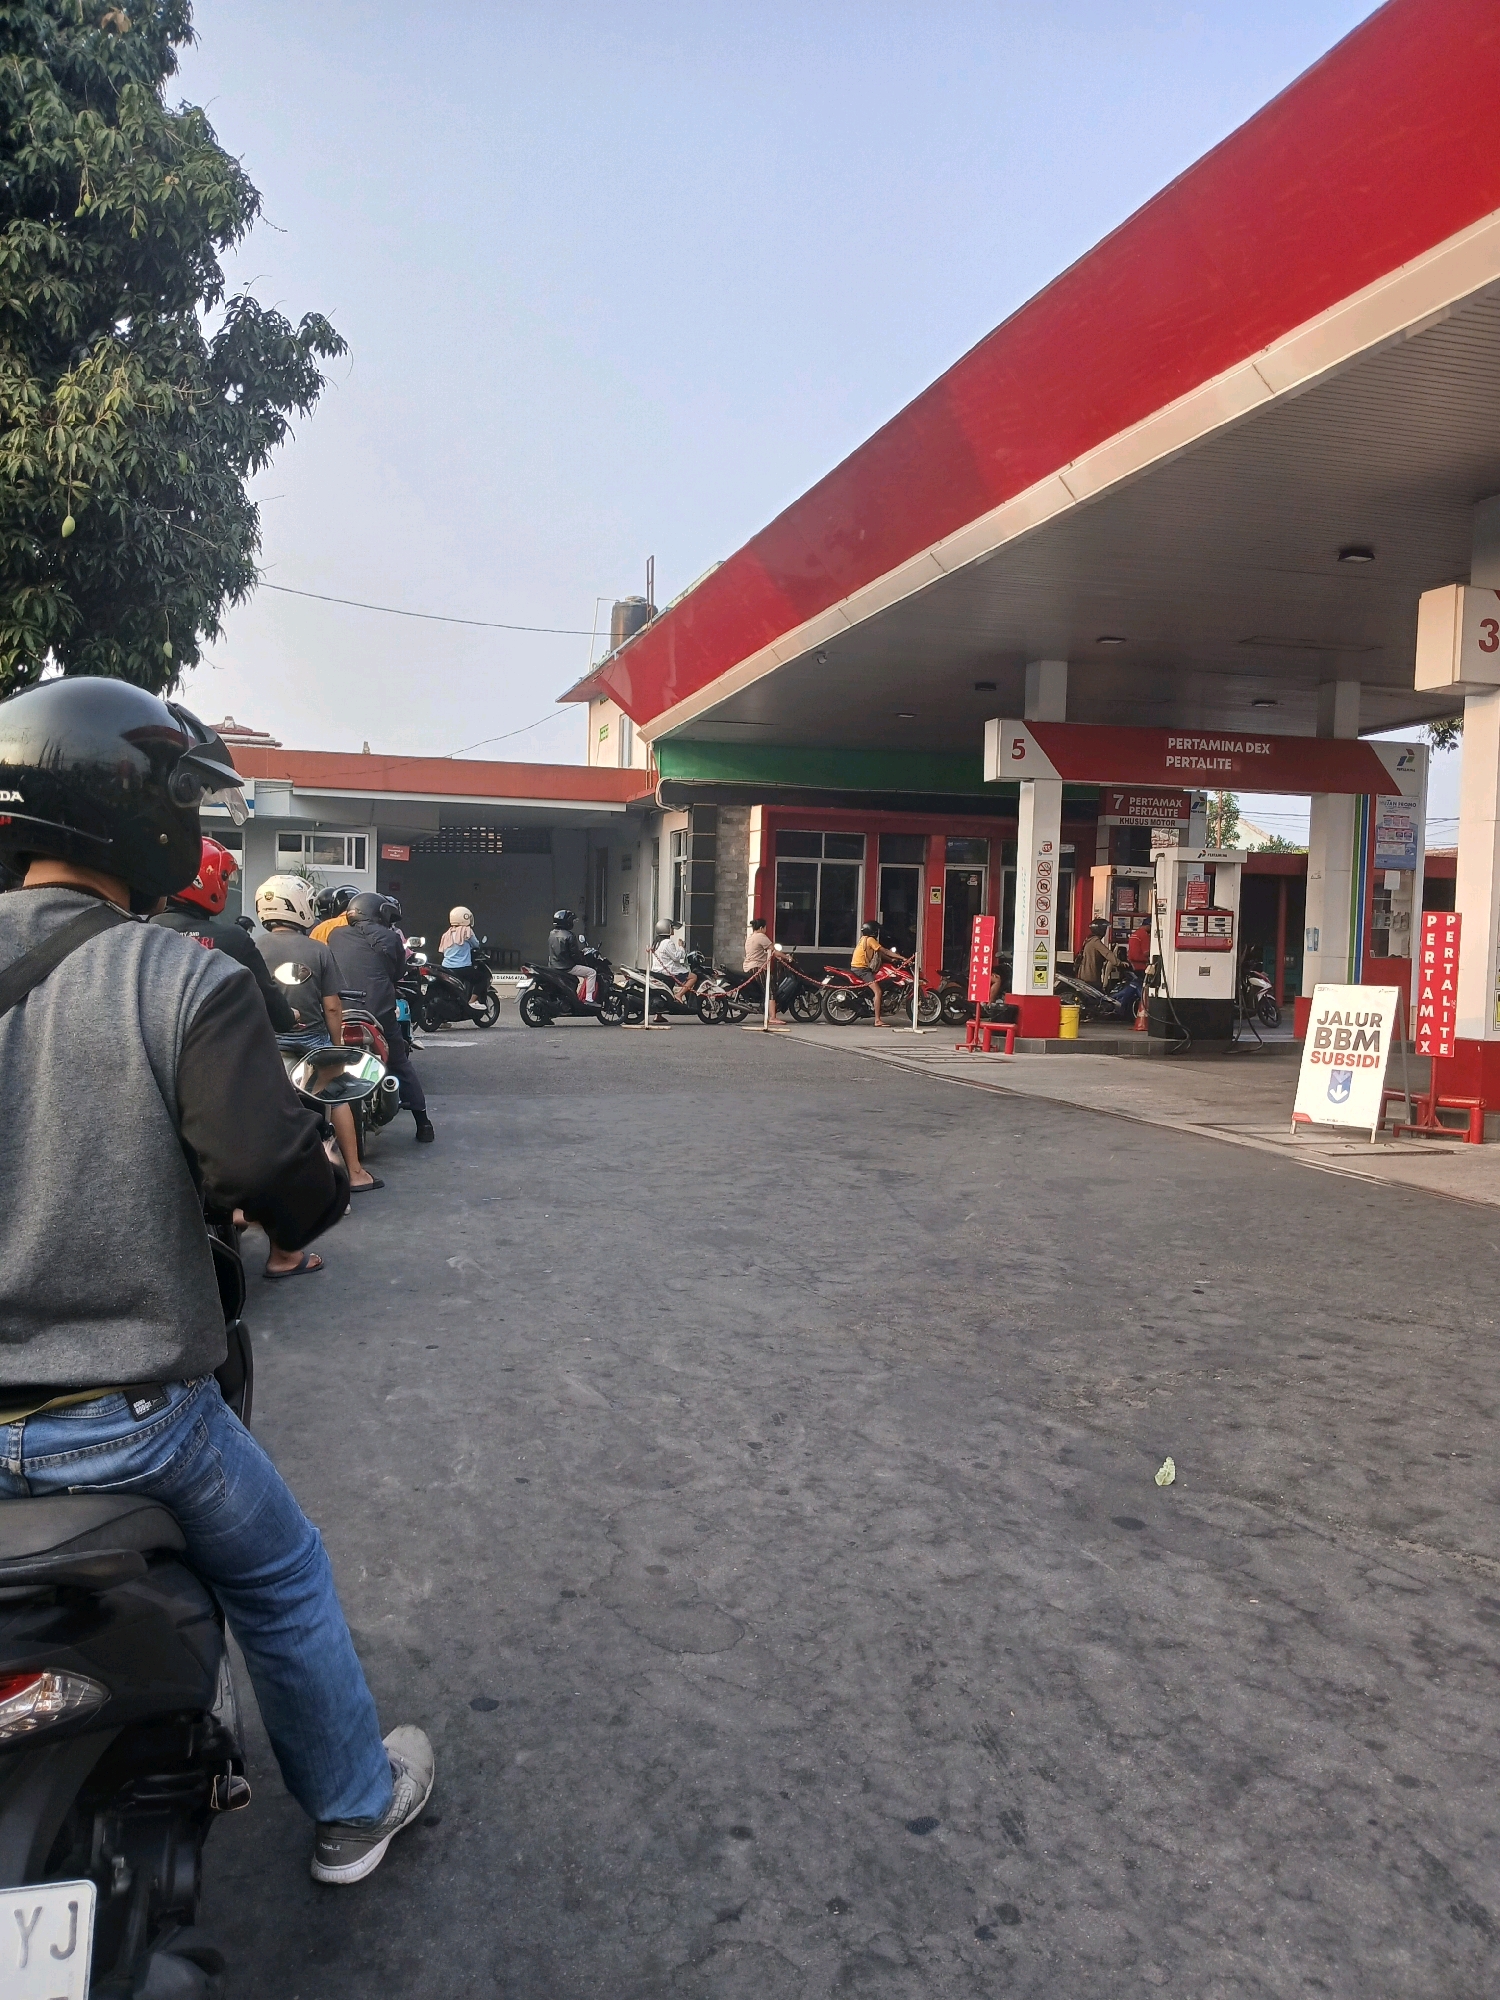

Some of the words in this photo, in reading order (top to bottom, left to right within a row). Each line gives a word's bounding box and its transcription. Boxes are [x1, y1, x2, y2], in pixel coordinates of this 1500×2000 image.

[1478, 617, 1500, 653] 3
[1011, 738, 1026, 760] 5
[1168, 737, 1244, 753] PERTAMINA
[1245, 742, 1271, 755] DEX
[1165, 755, 1232, 770] PERTALITE
[0, 790, 25, 803] DA
[1112, 793, 1125, 810] 7
[1129, 796, 1183, 808] PERTAMAX
[1128, 806, 1179, 818] PERTALITE
[1119, 817, 1149, 826] KHUSUS
[1149, 819, 1176, 827] MOTOR
[971, 917, 982, 1001] PERTALITE
[981, 945, 991, 976] DEX
[1419, 915, 1438, 1053] PERTAMAX
[1439, 915, 1456, 1055] PERTALITE
[1316, 1010, 1383, 1028] JALUR
[1313, 1026, 1381, 1053] BBM
[1310, 1050, 1380, 1069] SUBSIDI
[13, 1900, 79, 1969] YJ
